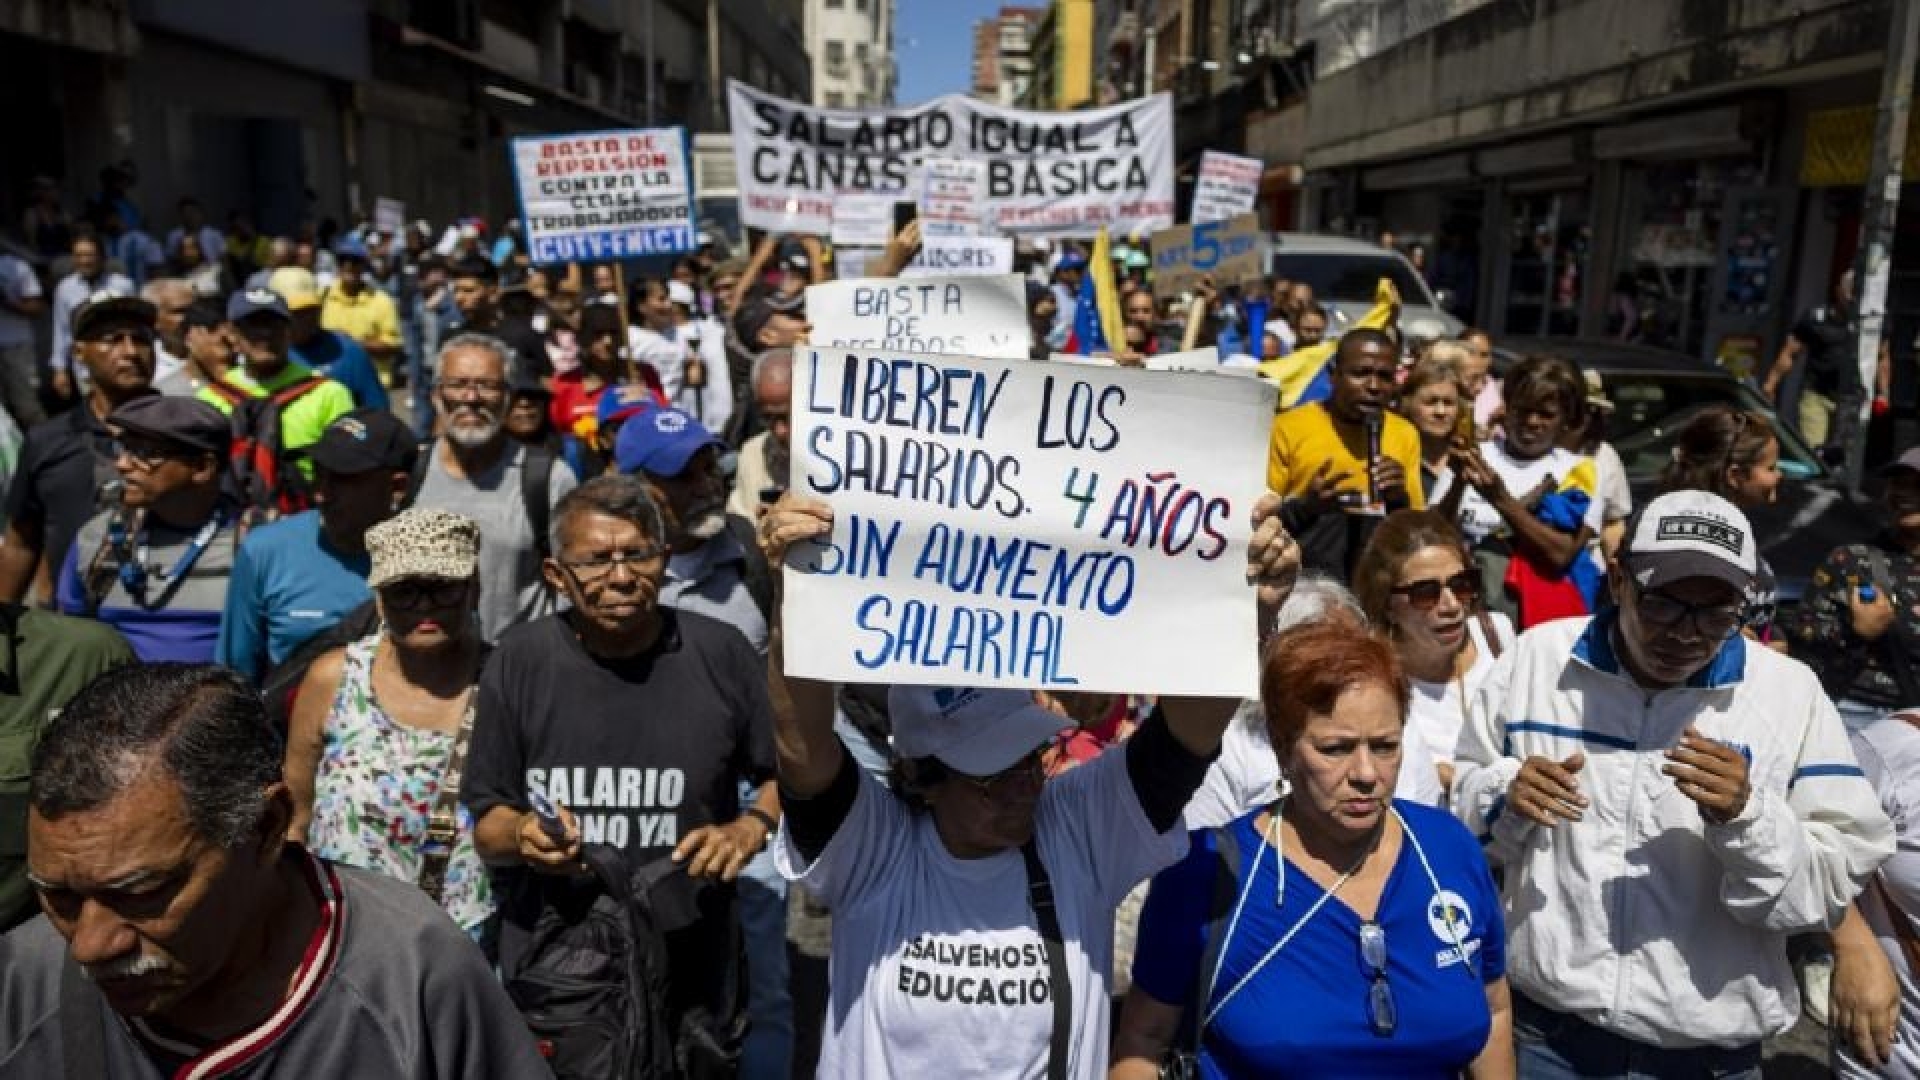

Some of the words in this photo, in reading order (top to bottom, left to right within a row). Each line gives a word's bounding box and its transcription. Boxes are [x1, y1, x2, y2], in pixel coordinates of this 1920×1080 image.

[754, 101, 952, 151] SALARIO
[970, 111, 1100, 152] IGUAL
[1114, 112, 1138, 147] A
[536, 153, 668, 177] REPRESION
[541, 137, 620, 159] BASTA
[627, 135, 654, 150] DE
[540, 175, 634, 195] CONTRA
[642, 171, 671, 186] LA
[754, 147, 922, 190] CANAS
[853, 283, 961, 317] BASTA
[886, 316, 920, 338] DE
[808, 351, 1011, 440] LIBEREN
[1035, 375, 1127, 451] LOS
[806, 425, 1031, 519] SALARIOS.
[1062, 466, 1099, 528] 4
[1100, 471, 1231, 561] AÑOS
[914, 522, 1136, 616] AUMENTO
[854, 594, 1079, 685] SALARIAL
[526, 767, 685, 807] SALARIO
[637, 814, 677, 848] YA
[898, 965, 1051, 1006] EDUCACIÓ
